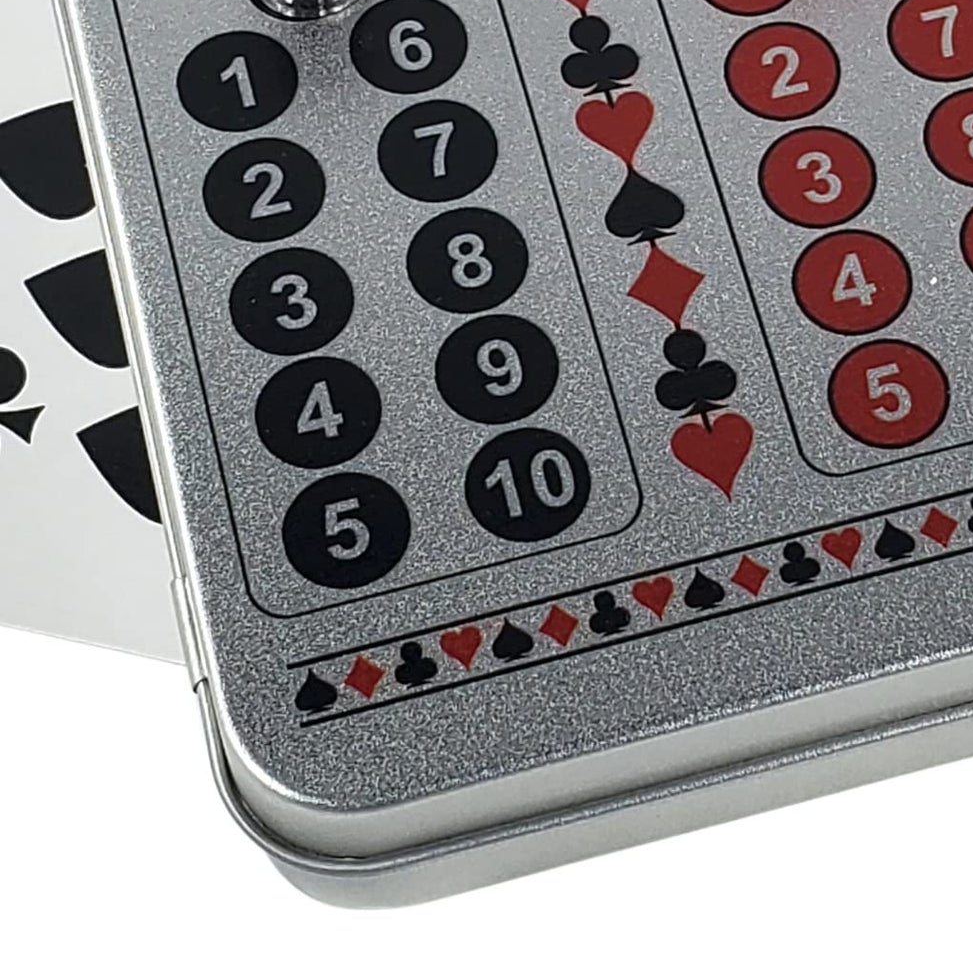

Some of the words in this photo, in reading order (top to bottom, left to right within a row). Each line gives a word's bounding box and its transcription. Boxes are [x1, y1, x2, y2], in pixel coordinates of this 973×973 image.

[389, 20, 433, 71] 6
[920, 4, 959, 58] 7
[220, 56, 256, 107] 1
[761, 45, 809, 99] 2
[414, 121, 454, 177] 7
[243, 162, 292, 219] 2
[796, 151, 842, 204] 3
[447, 233, 493, 288] 8
[832, 253, 877, 306] 4
[271, 274, 318, 329] 3
[477, 339, 523, 396] 9
[866, 363, 912, 422] 5
[297, 381, 344, 437] 4
[485, 449, 572, 517] 10
[325, 498, 370, 559] 5
